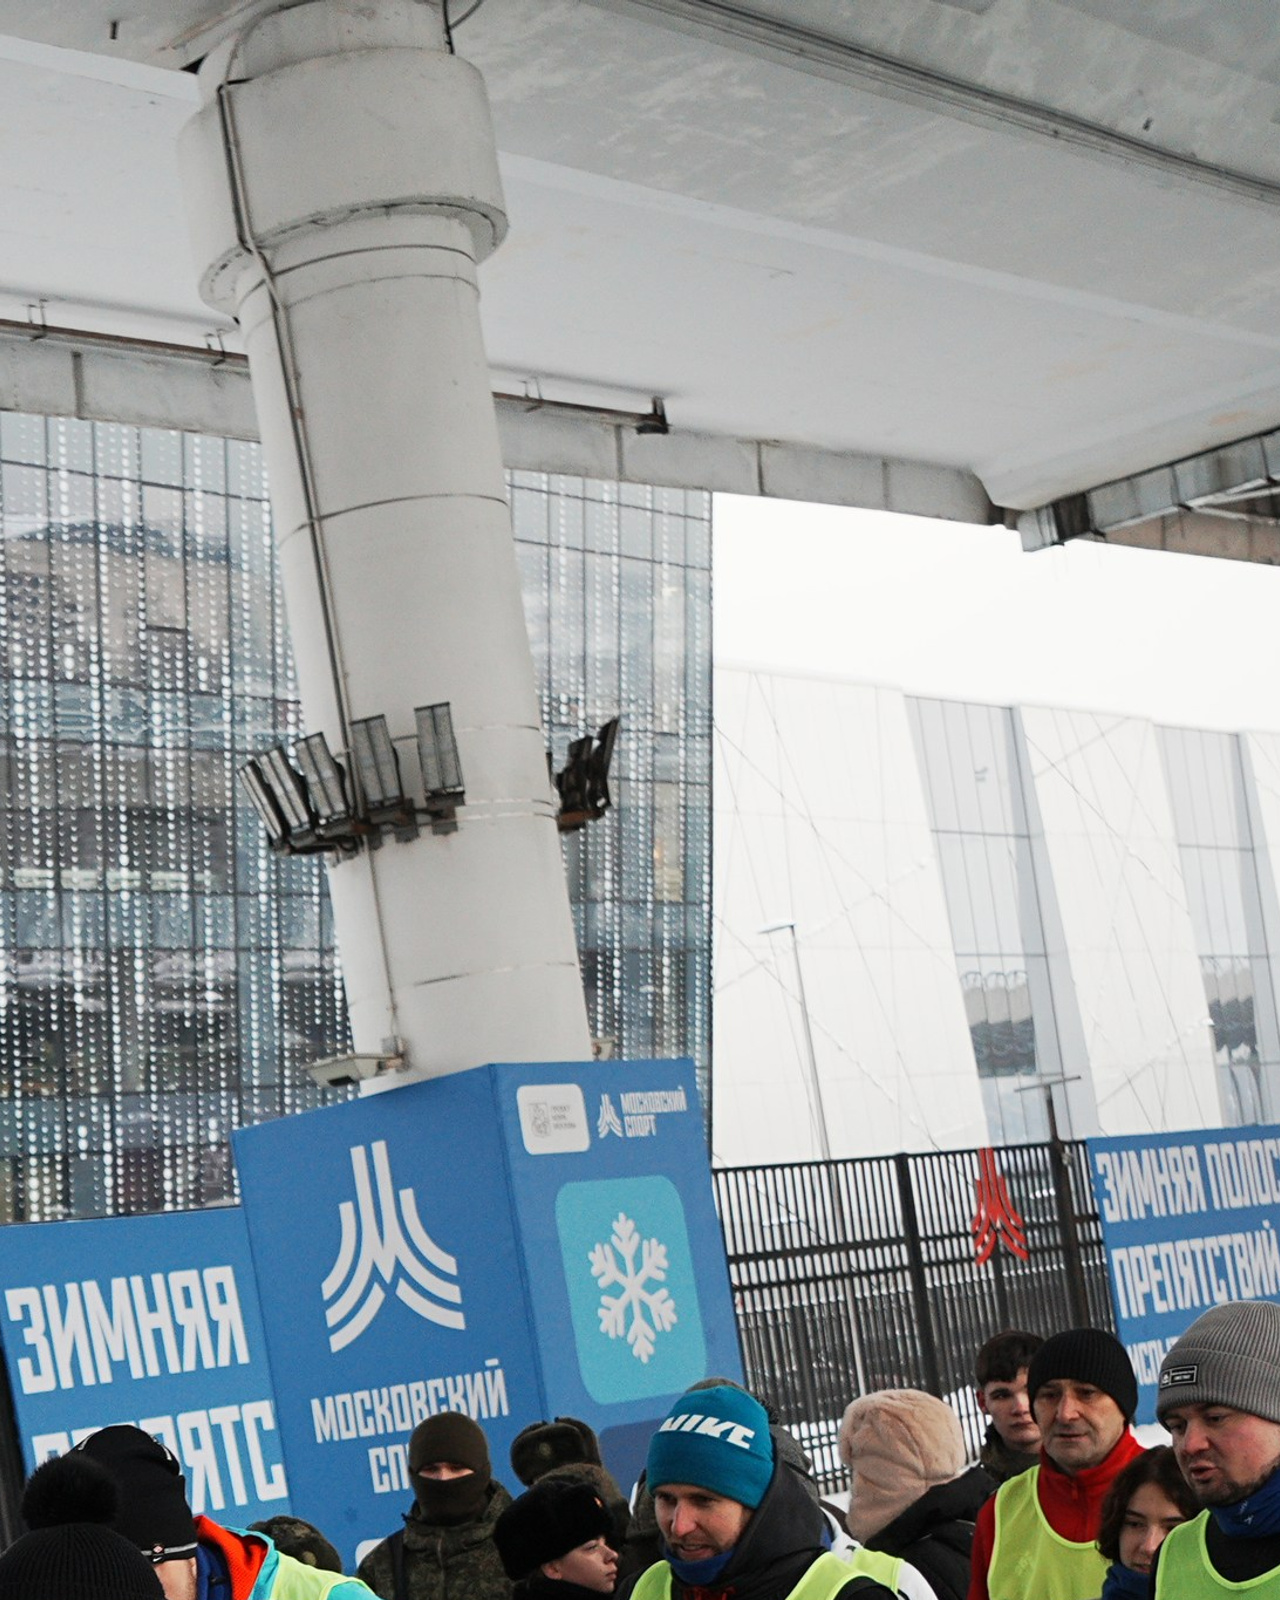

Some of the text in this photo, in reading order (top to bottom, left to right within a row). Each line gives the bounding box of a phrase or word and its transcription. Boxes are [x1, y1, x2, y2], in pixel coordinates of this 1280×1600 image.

[624, 1114, 657, 1138] СПОРТ
[1095, 1137, 1280, 1223] ЗИМНЯЯ ПОЛОС
[1111, 1219, 1280, 1319] ПРЕПЯТСТВИЙ
[4, 1265, 251, 1395] ЗИМНЯЯ
[311, 1358, 509, 1443] МОСКОВСКИЙ
[659, 1413, 756, 1450] NIKE
[368, 1443, 411, 1494] СП
